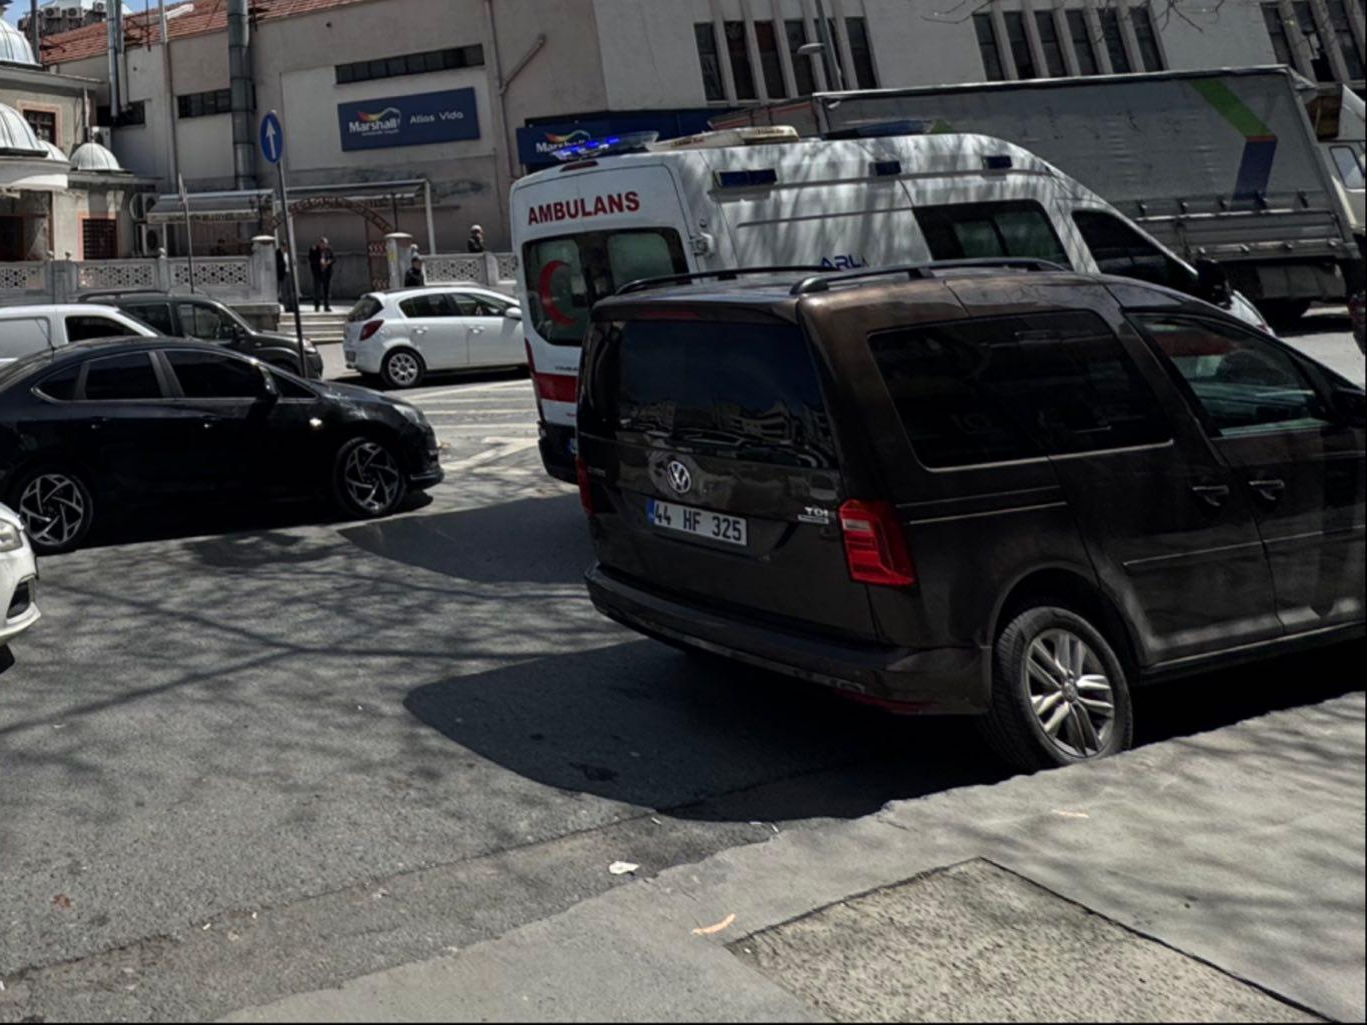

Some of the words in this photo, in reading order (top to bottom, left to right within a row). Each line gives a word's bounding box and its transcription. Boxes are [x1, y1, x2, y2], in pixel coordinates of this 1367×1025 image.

[349, 117, 398, 134] Marshall
[527, 191, 640, 226] AMBULANS
[654, 504, 672, 525] 44
[683, 508, 701, 531] HF
[711, 516, 742, 541] 325
